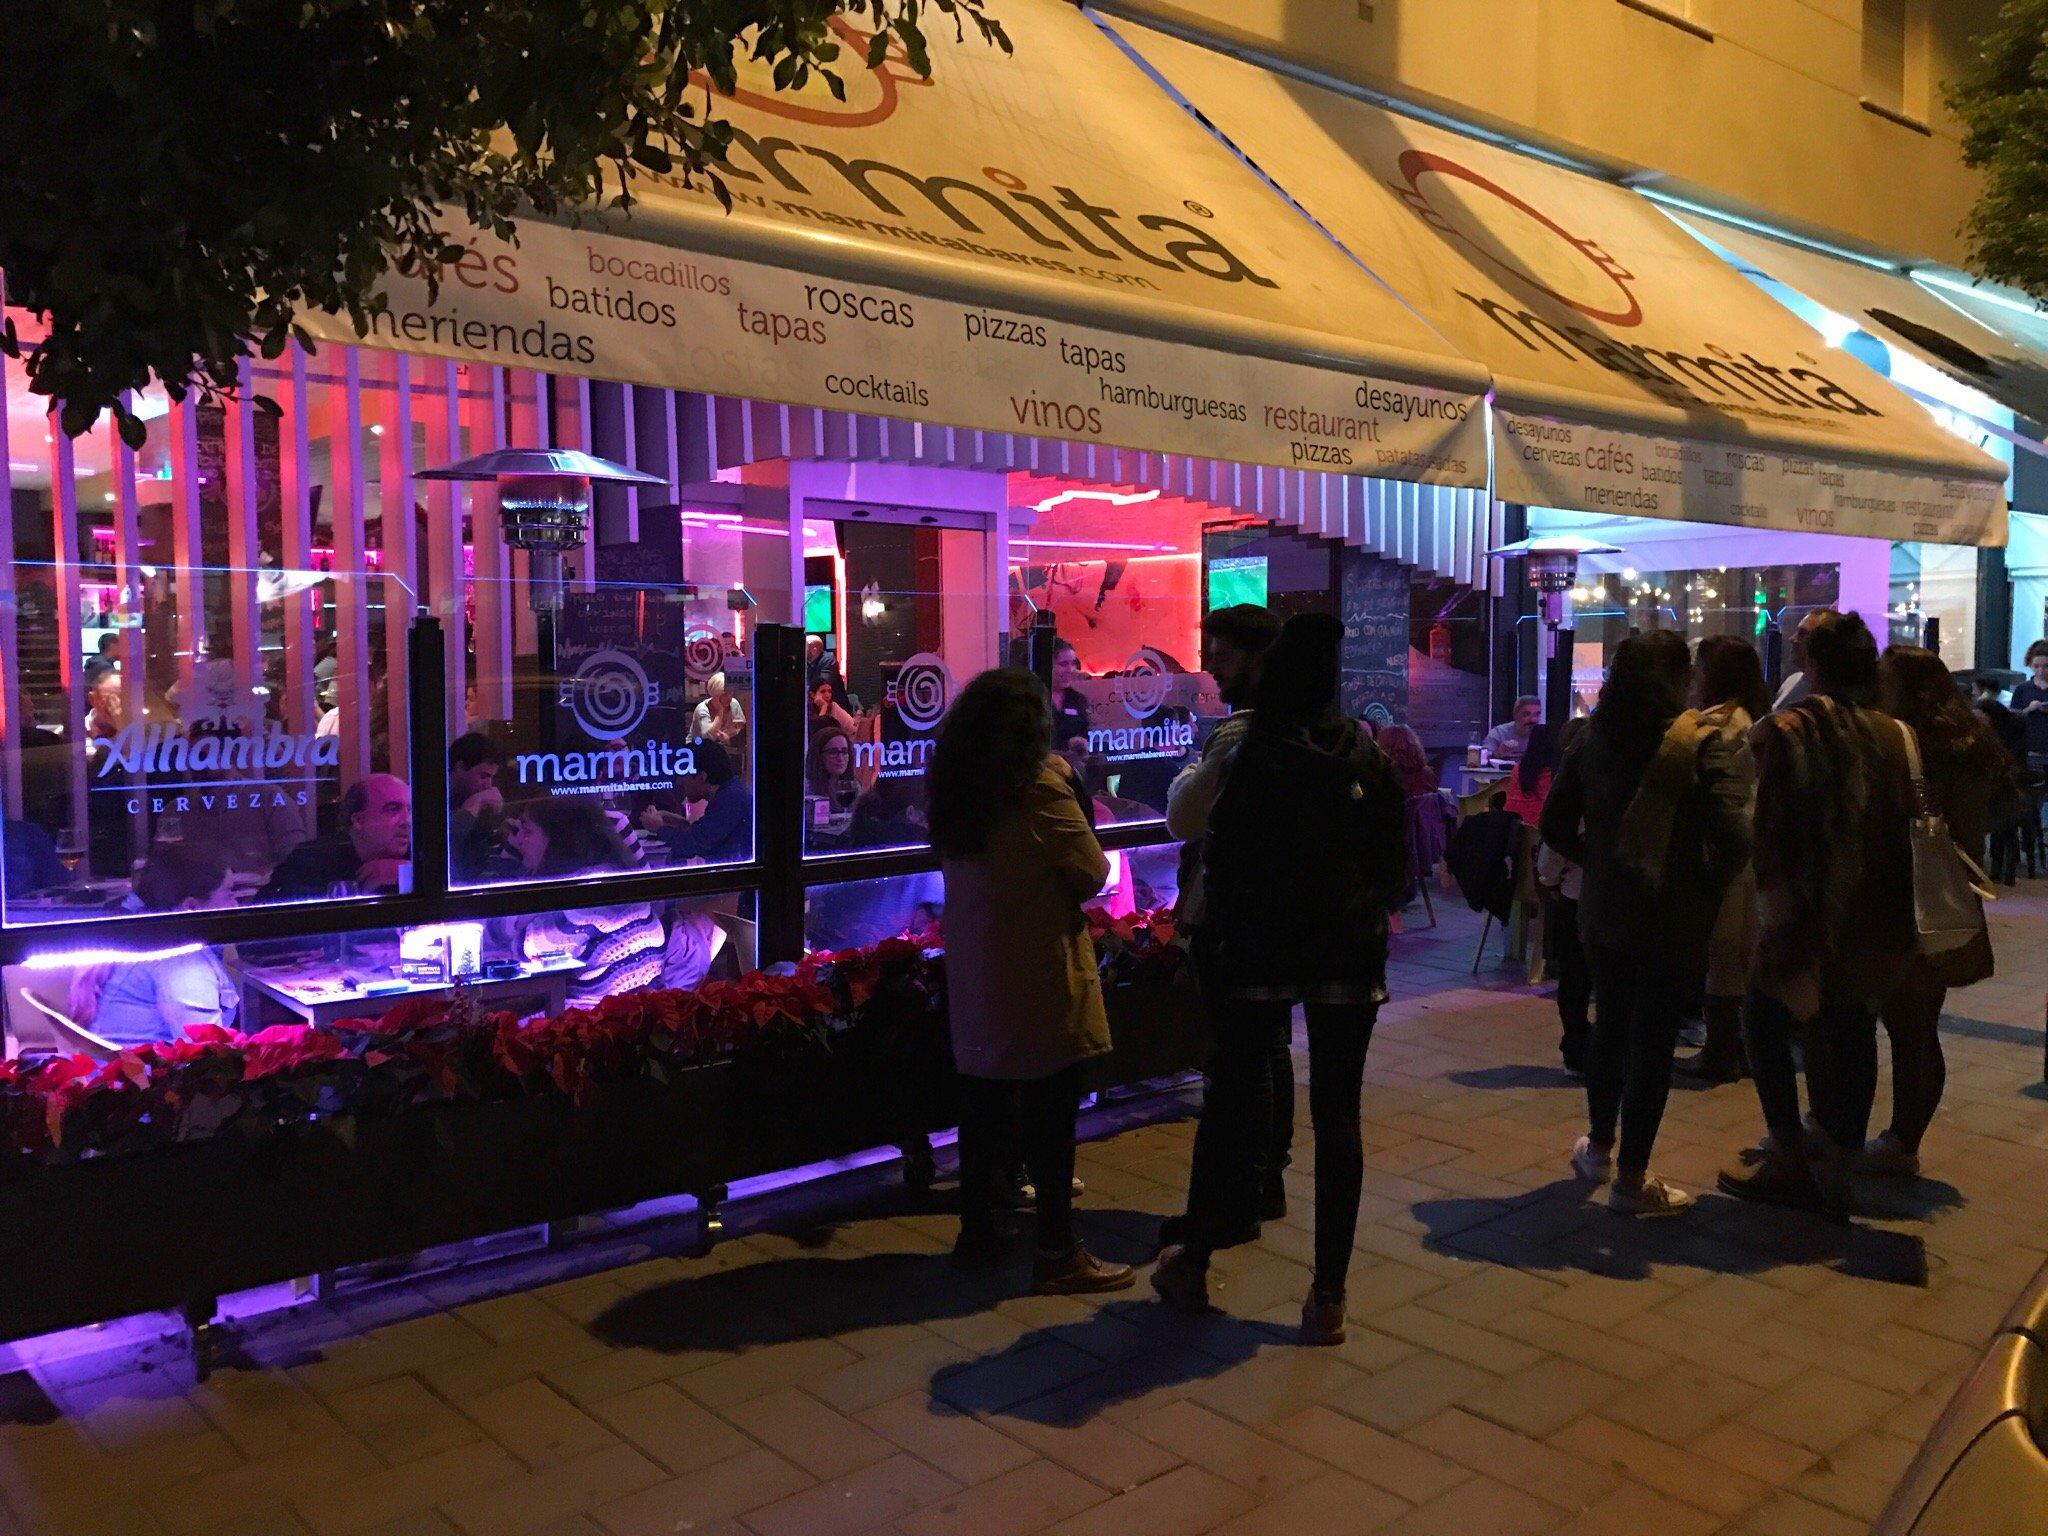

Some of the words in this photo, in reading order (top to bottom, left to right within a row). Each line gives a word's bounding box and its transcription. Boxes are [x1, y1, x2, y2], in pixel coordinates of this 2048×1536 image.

[586, 246, 731, 296] bocadillos
[546, 276, 677, 328] batidos
[804, 283, 914, 330] roscas
[737, 301, 828, 345] tapas
[964, 309, 1047, 348] pizzas
[1059, 335, 1126, 374] tapas
[1452, 288, 1886, 418] marmita
[824, 371, 929, 408] cocktails
[1099, 376, 1248, 423] hamburguesas
[1354, 381, 1467, 422] desayunos
[1010, 389, 1102, 435] vinos
[1263, 401, 1380, 443] restaurant
[1507, 417, 1572, 444] desayunos
[1290, 439, 1353, 467] pizzas
[1523, 445, 1581, 467] cervezas
[1585, 442, 1634, 474] cafés
[1584, 484, 1658, 511] meriendas
[1796, 506, 1835, 528] vinos
[93, 722, 339, 778] Alhambra
[1088, 718, 1193, 753] marmita
[517, 739, 697, 783] marmita
[127, 791, 308, 814] CERVEZAS
[551, 780, 673, 796] www.marmitabares.com
